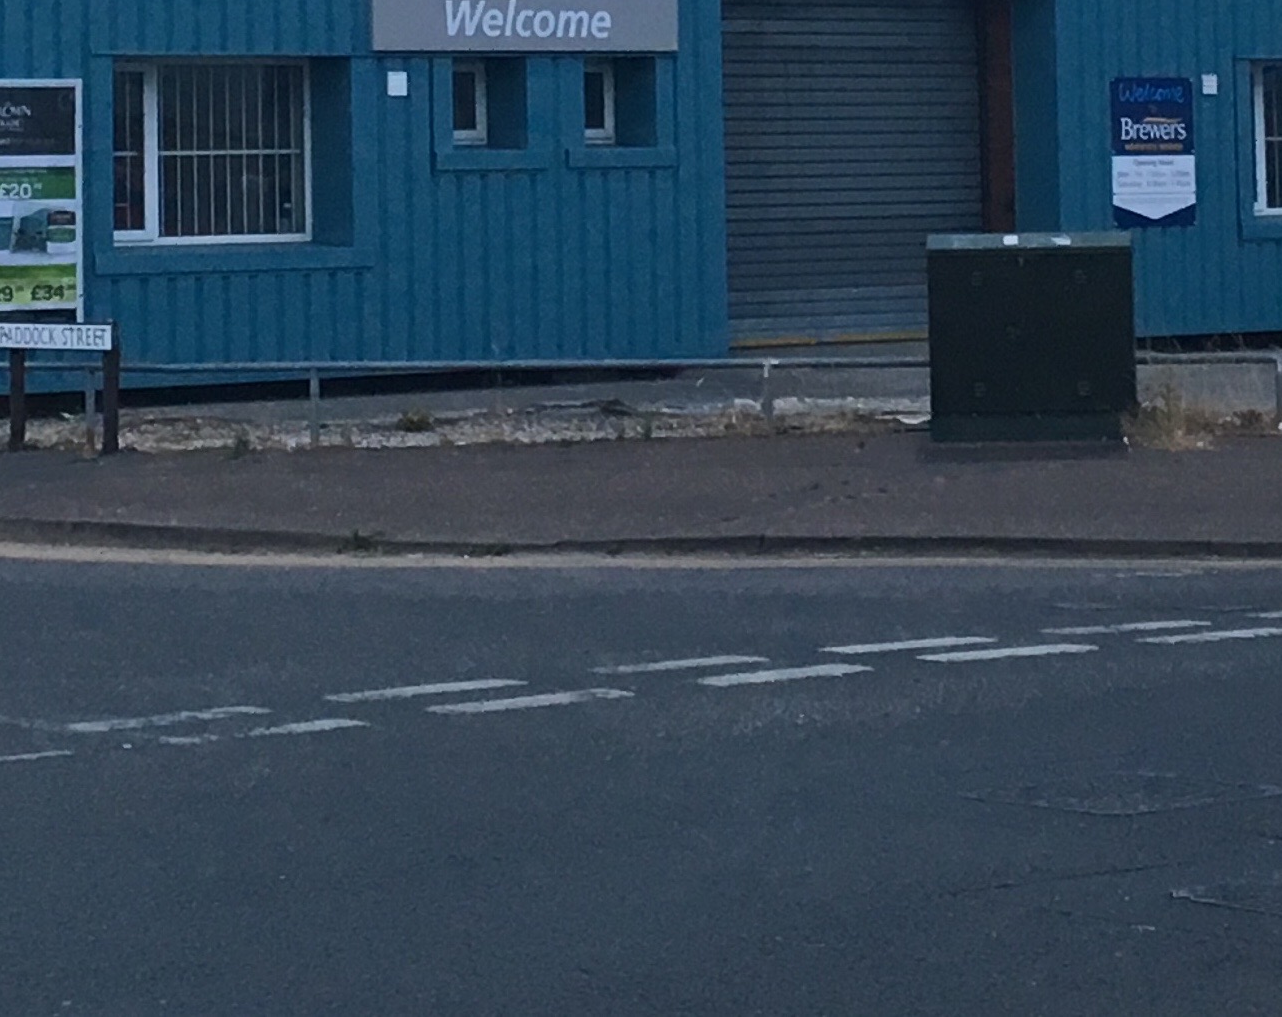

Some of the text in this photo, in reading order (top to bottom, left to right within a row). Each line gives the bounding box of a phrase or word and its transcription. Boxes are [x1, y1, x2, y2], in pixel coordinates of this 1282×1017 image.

[1121, 117, 1187, 140] Brewers
[0, 325, 107, 346] PADDOCK STREET
